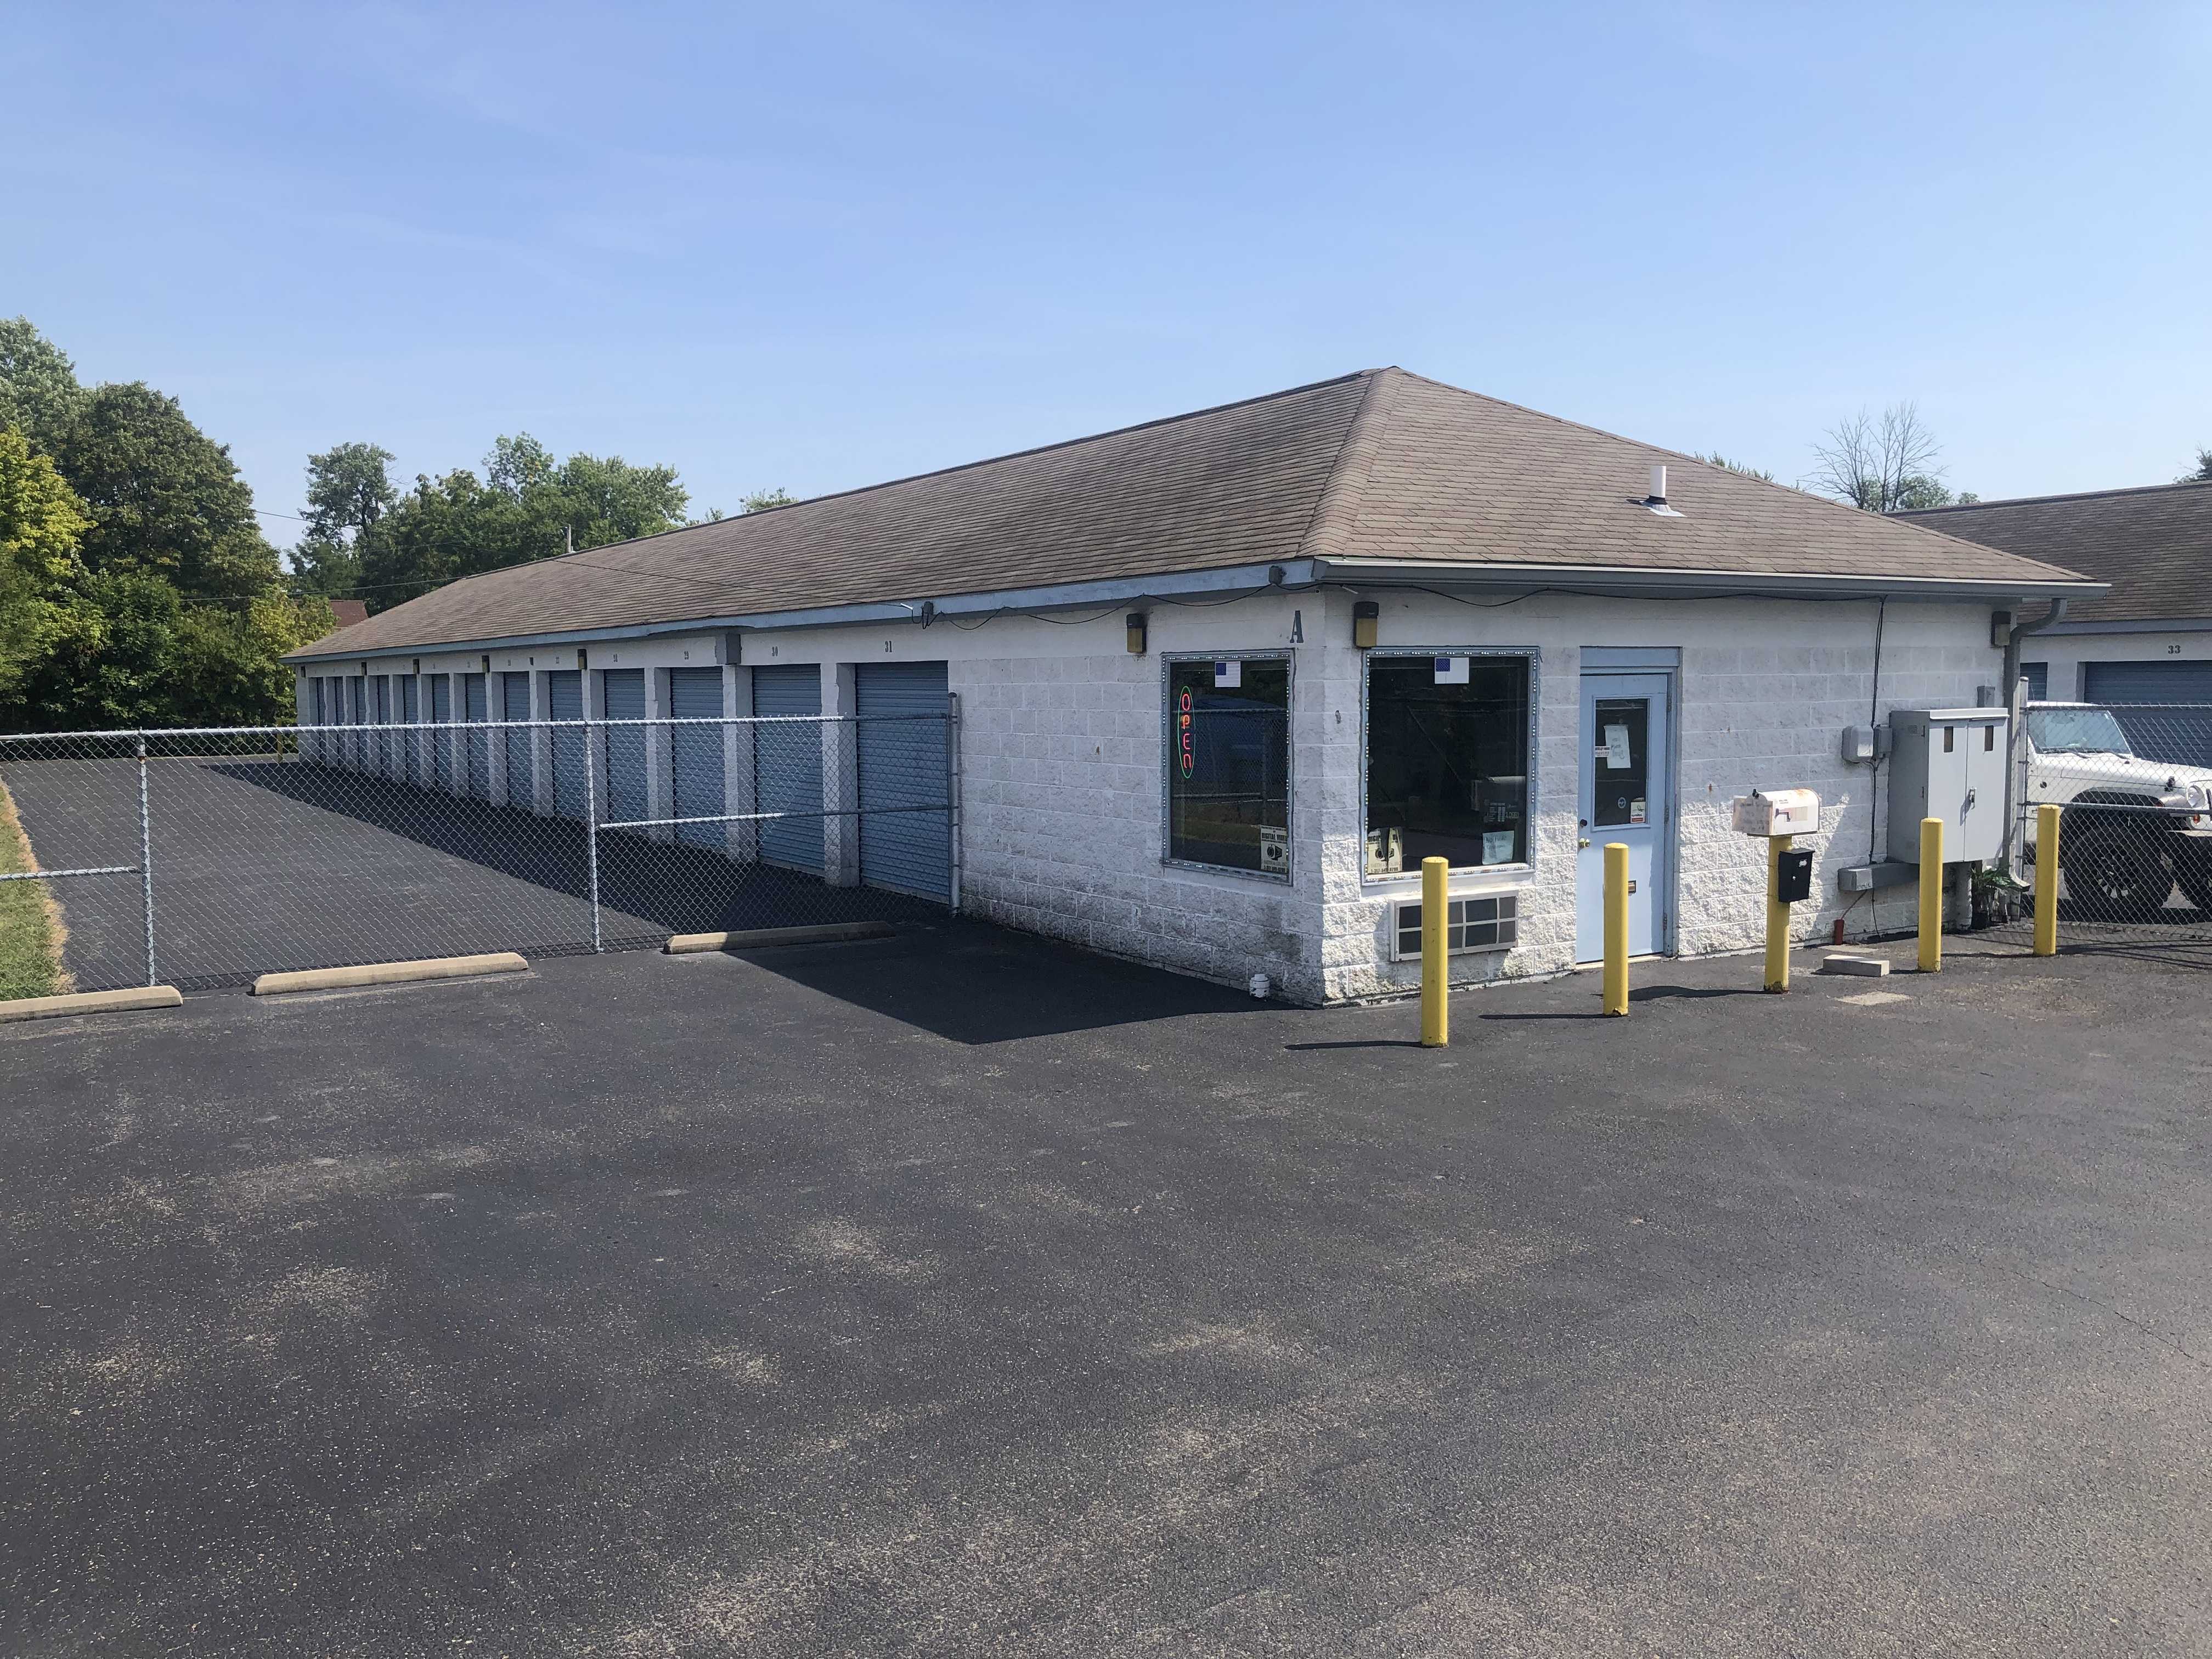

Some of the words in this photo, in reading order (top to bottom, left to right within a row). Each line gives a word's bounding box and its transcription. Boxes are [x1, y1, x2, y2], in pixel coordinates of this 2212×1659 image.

[1290, 610, 1304, 643] A
[772, 646, 778, 656] 30
[885, 641, 892, 652] 31
[2168, 645, 2181, 654] 33
[1182, 693, 1192, 769] OPEN
